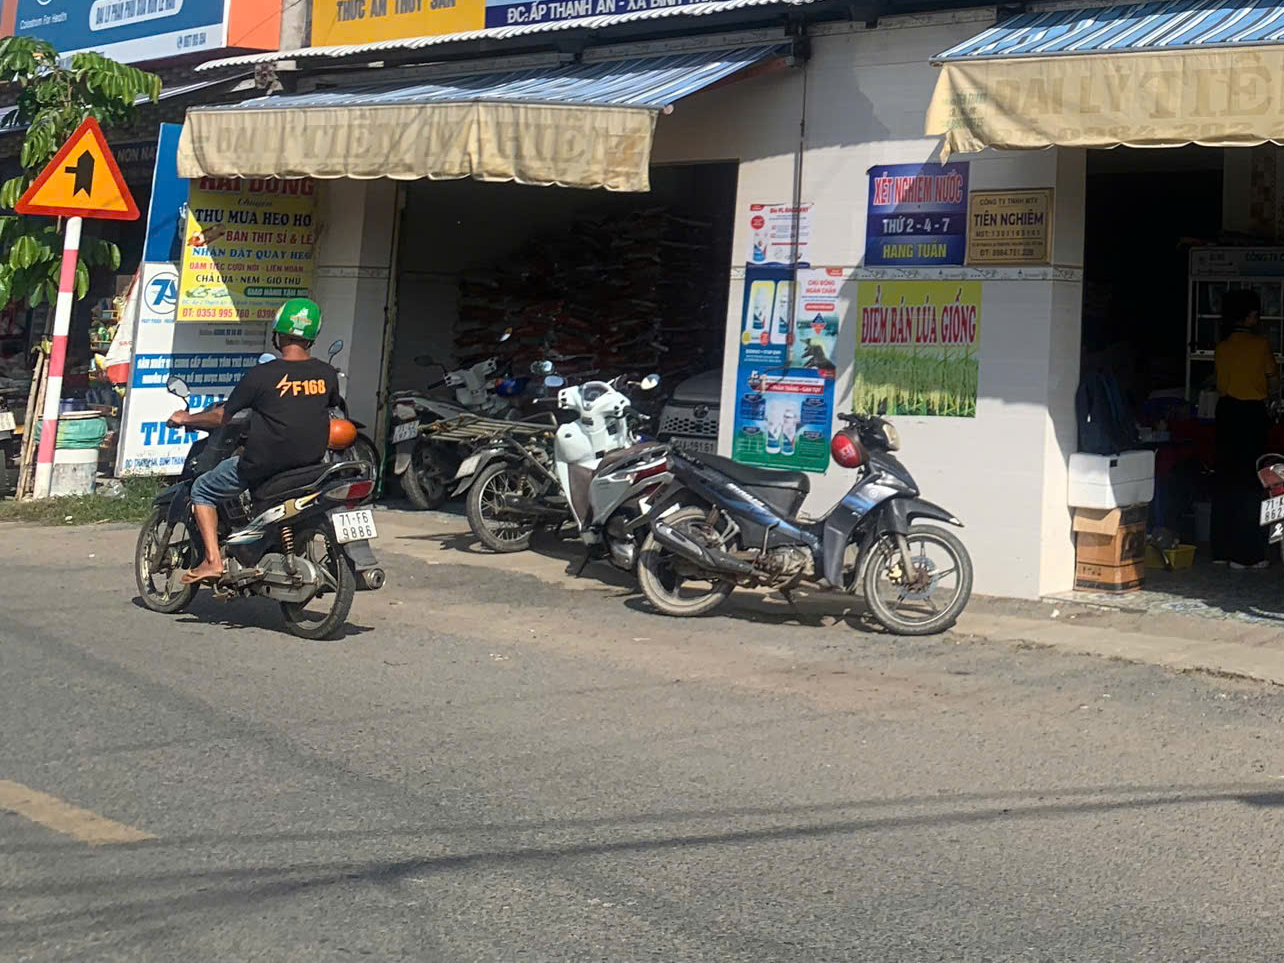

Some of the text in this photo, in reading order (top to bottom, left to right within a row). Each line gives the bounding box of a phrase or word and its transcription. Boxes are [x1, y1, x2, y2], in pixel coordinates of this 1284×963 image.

[873, 171, 895, 205] XÉT
[195, 209, 289, 226] THU MUA HEO
[883, 215, 905, 233] THỨ
[219, 308, 233, 318] 995
[861, 285, 977, 345] ĐIỂM BÁN LÚA GIỐNG
[293, 379, 326, 397] F168
